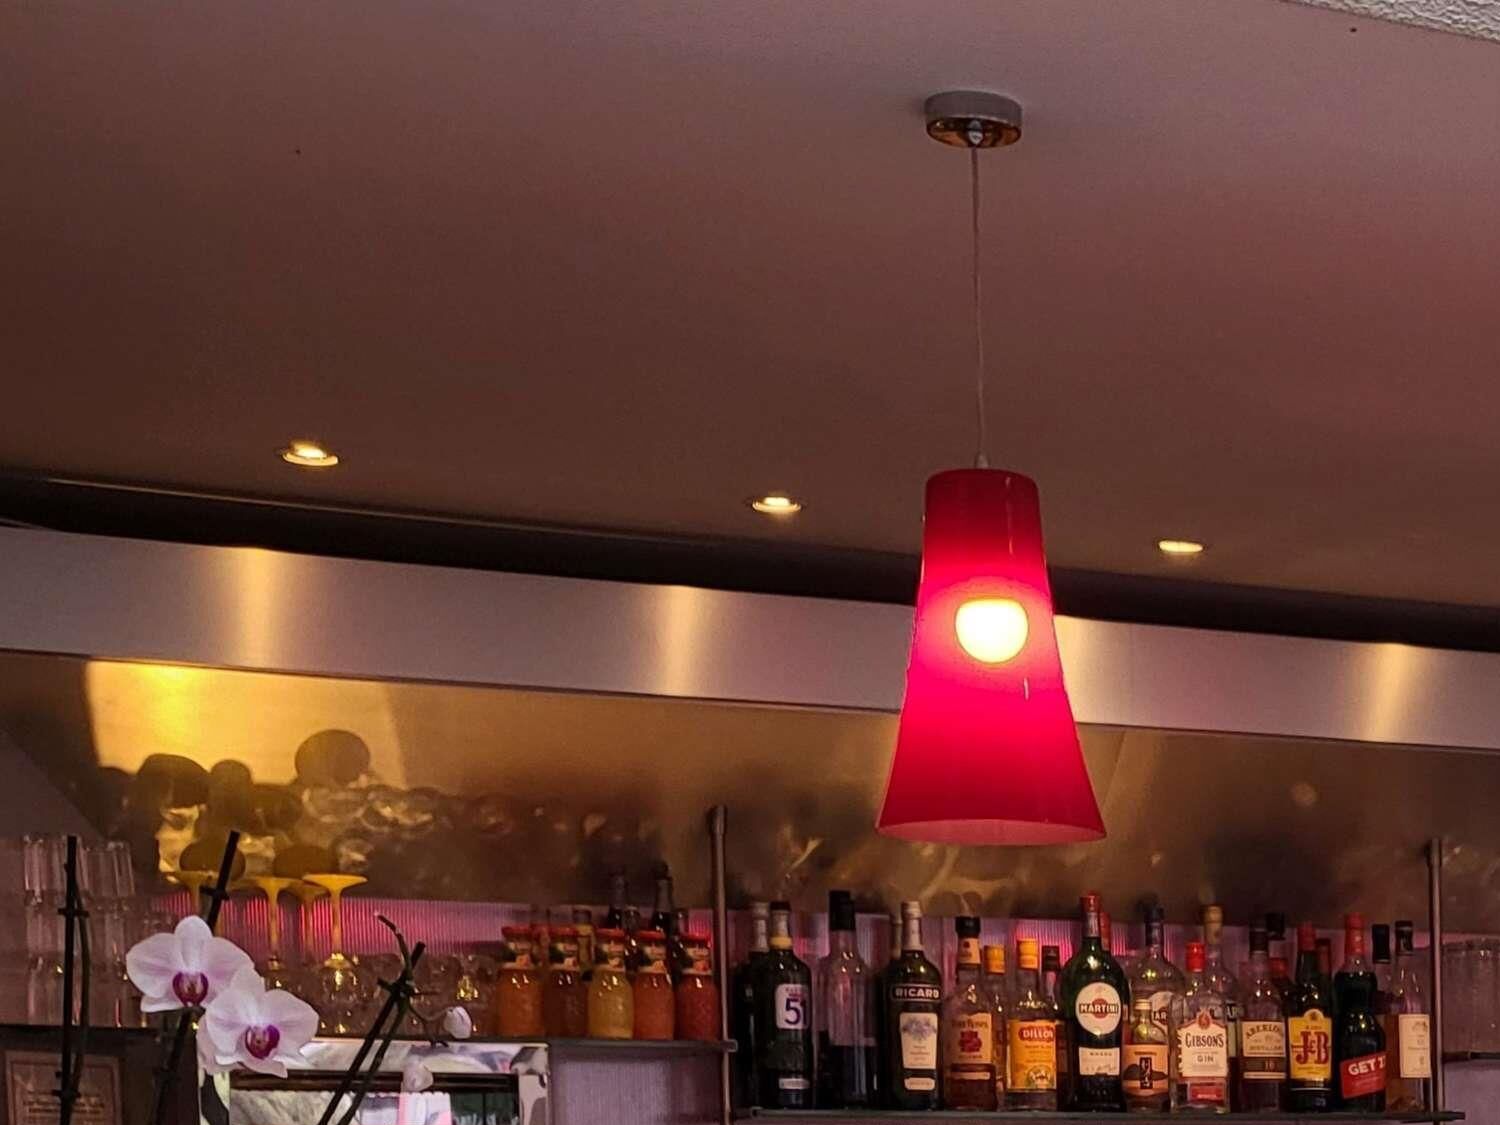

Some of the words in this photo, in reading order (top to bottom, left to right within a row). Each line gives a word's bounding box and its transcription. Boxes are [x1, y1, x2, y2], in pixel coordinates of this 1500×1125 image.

[895, 987, 940, 999] RICARD
[1080, 1003, 1118, 1014] MARTINI
[1197, 1055, 1215, 1063] GIN
[1348, 1059, 1376, 1076] GET
